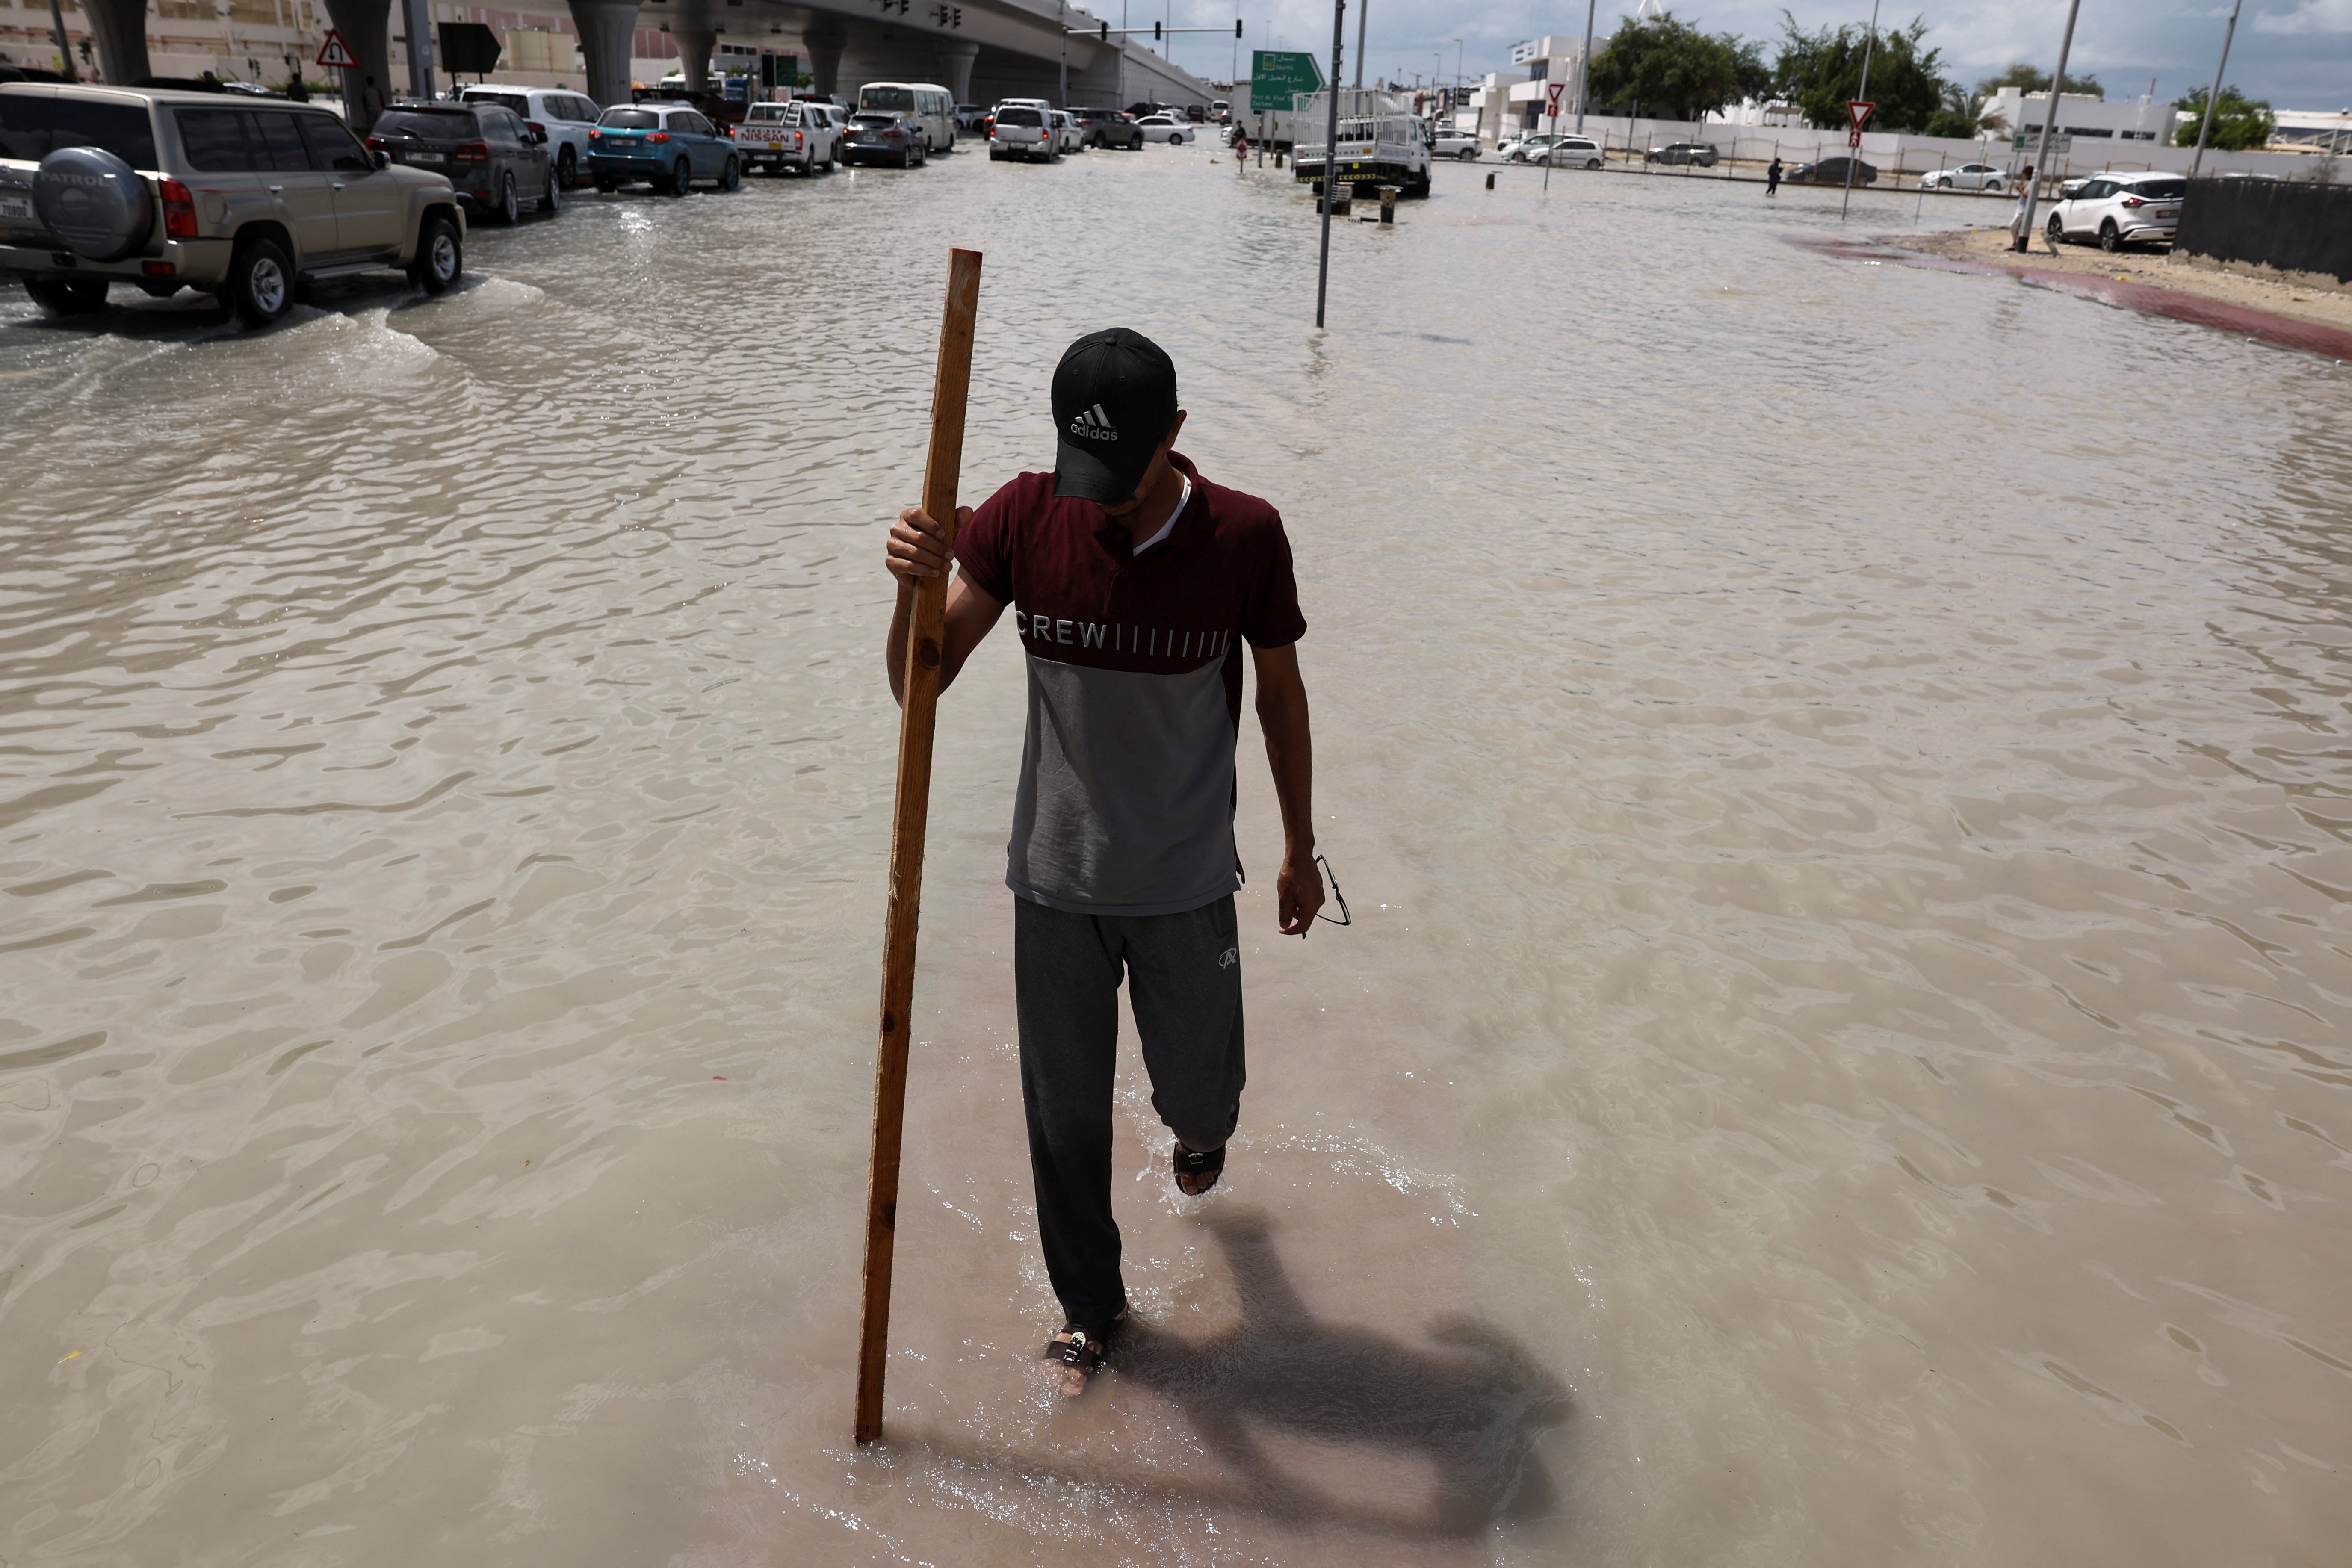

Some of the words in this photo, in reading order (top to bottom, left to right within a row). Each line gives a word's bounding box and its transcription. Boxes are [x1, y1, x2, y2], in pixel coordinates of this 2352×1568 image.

[741, 133, 789, 142] NISSAN
[41, 172, 110, 187] PATROL
[1070, 423, 1118, 441] adidas
